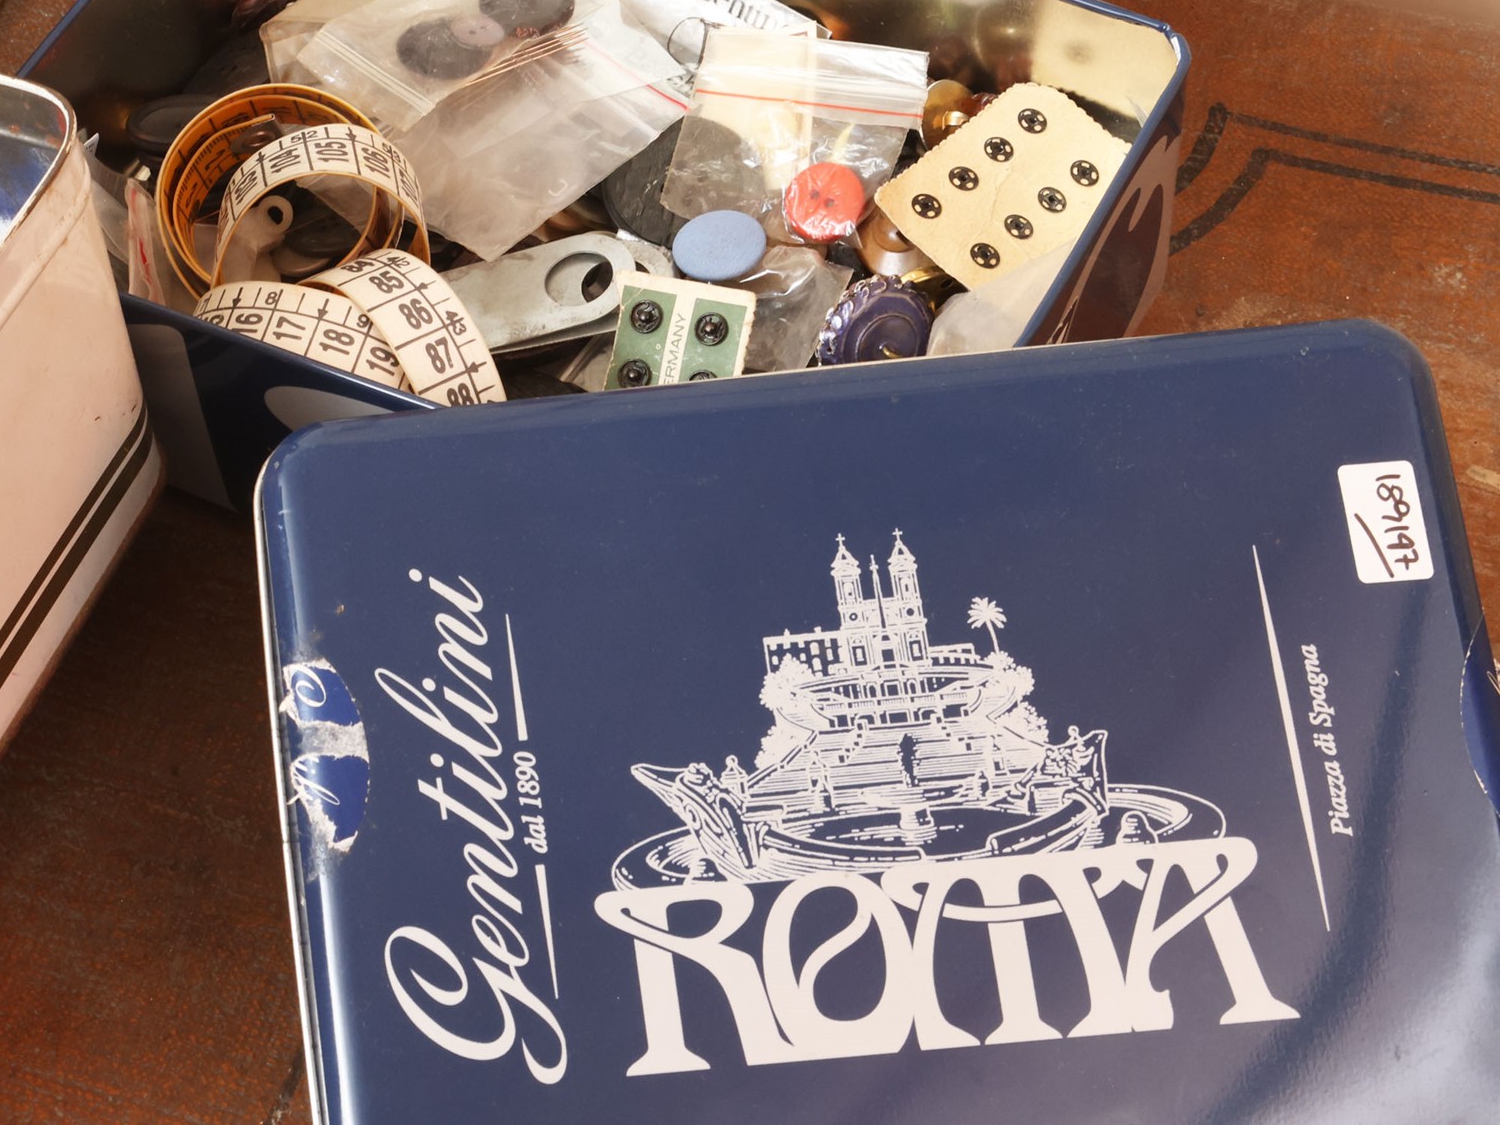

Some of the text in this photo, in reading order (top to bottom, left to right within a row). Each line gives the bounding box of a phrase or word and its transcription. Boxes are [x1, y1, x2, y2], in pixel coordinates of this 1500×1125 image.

[270, 147, 300, 174] 104
[314, 140, 349, 163] 105
[361, 147, 390, 178] 106
[232, 313, 263, 333] 16
[272, 316, 307, 341] 17
[319, 328, 356, 356] 18
[366, 346, 400, 376] 19
[264, 291, 278, 305] 8
[369, 270, 404, 294] 85
[399, 298, 432, 329] 86
[425, 337, 455, 374] 87
[663, 313, 687, 386] ERMANY
[1300, 644, 1354, 837] Piazza di Spagna
[374, 568, 568, 1085] Gentilini
[513, 750, 549, 855] dal 1890
[594, 836, 1302, 1077] ROMA
